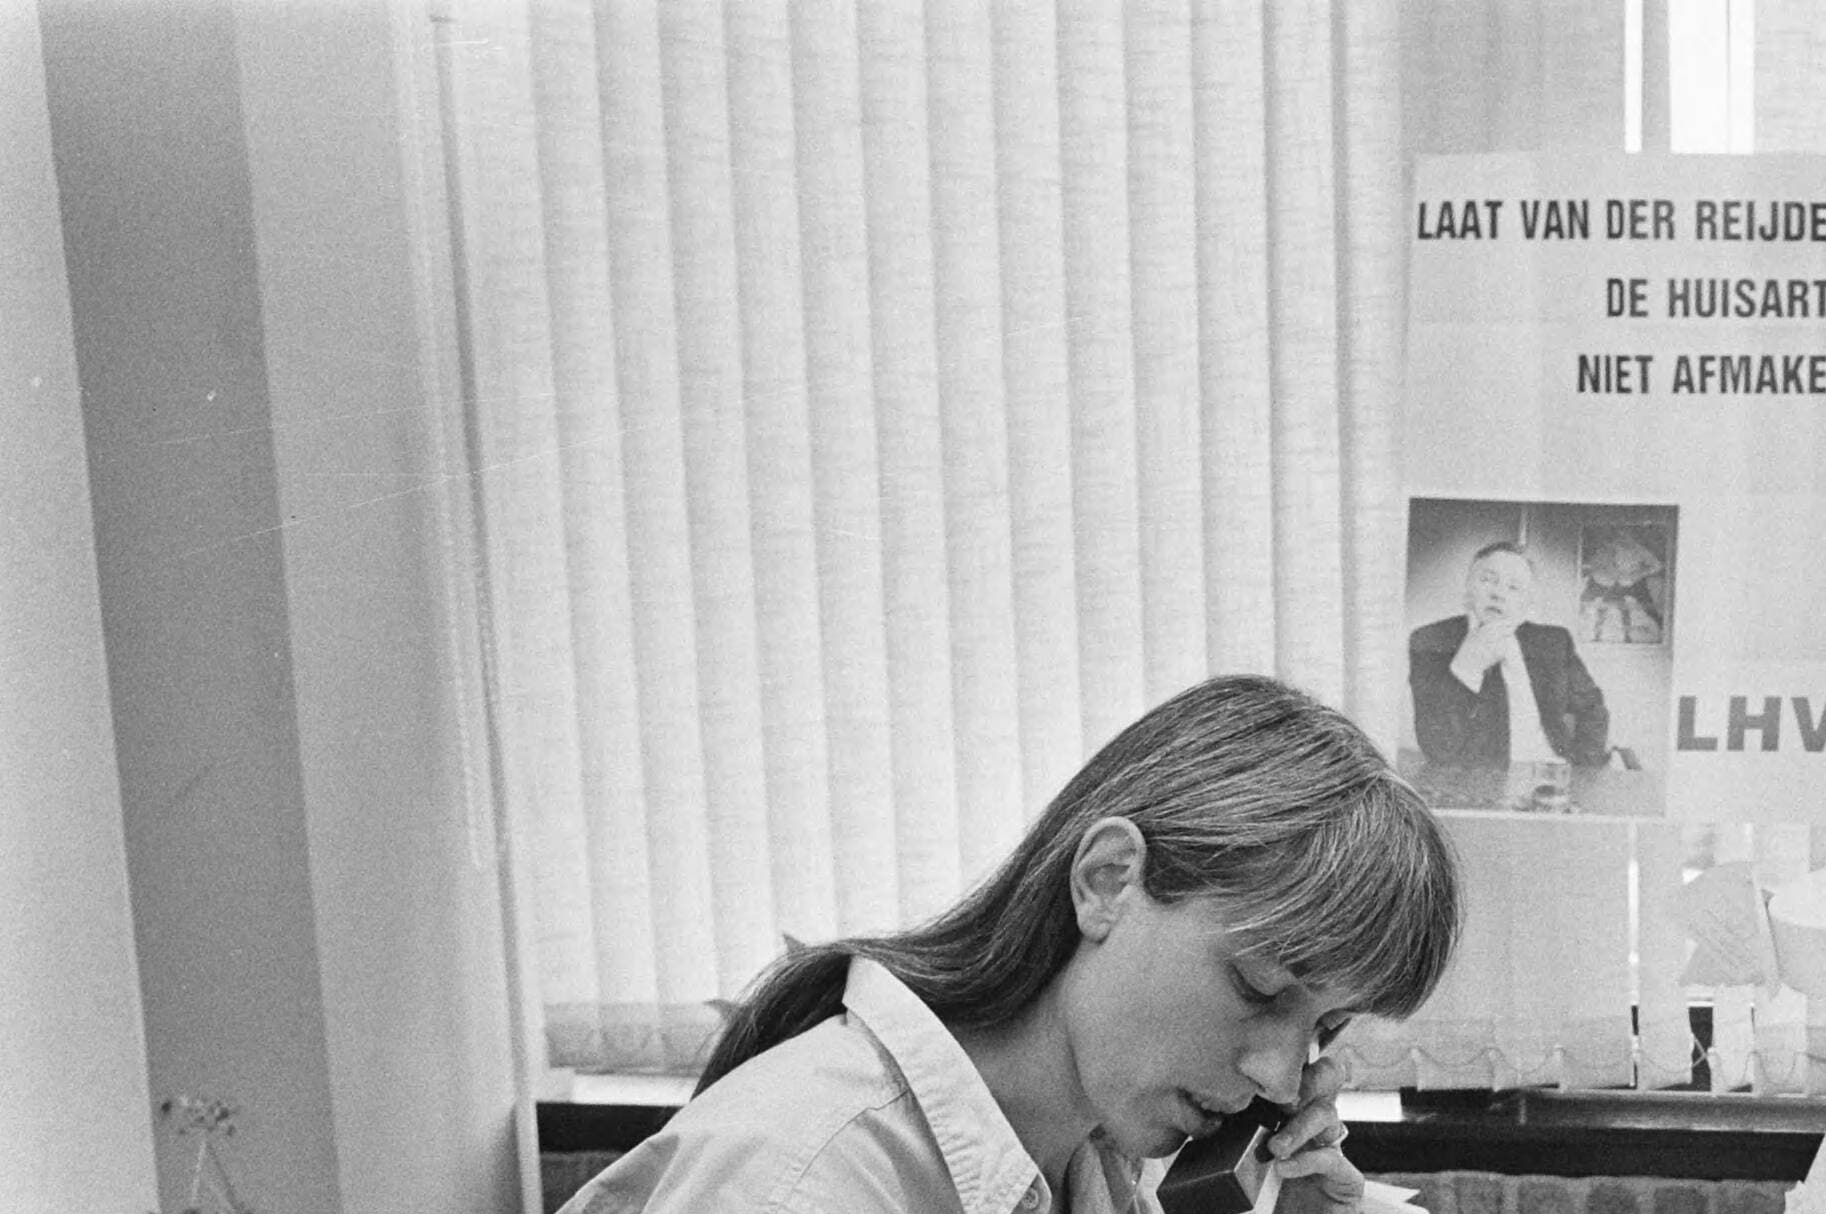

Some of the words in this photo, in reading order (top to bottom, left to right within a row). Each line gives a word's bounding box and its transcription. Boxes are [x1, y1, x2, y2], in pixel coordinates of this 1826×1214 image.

[1417, 200, 1503, 241] LAAT
[1520, 199, 1590, 240] VAN
[1606, 199, 1675, 240] DER
[1607, 277, 1648, 318] DE
[1576, 354, 1653, 394] NIET
